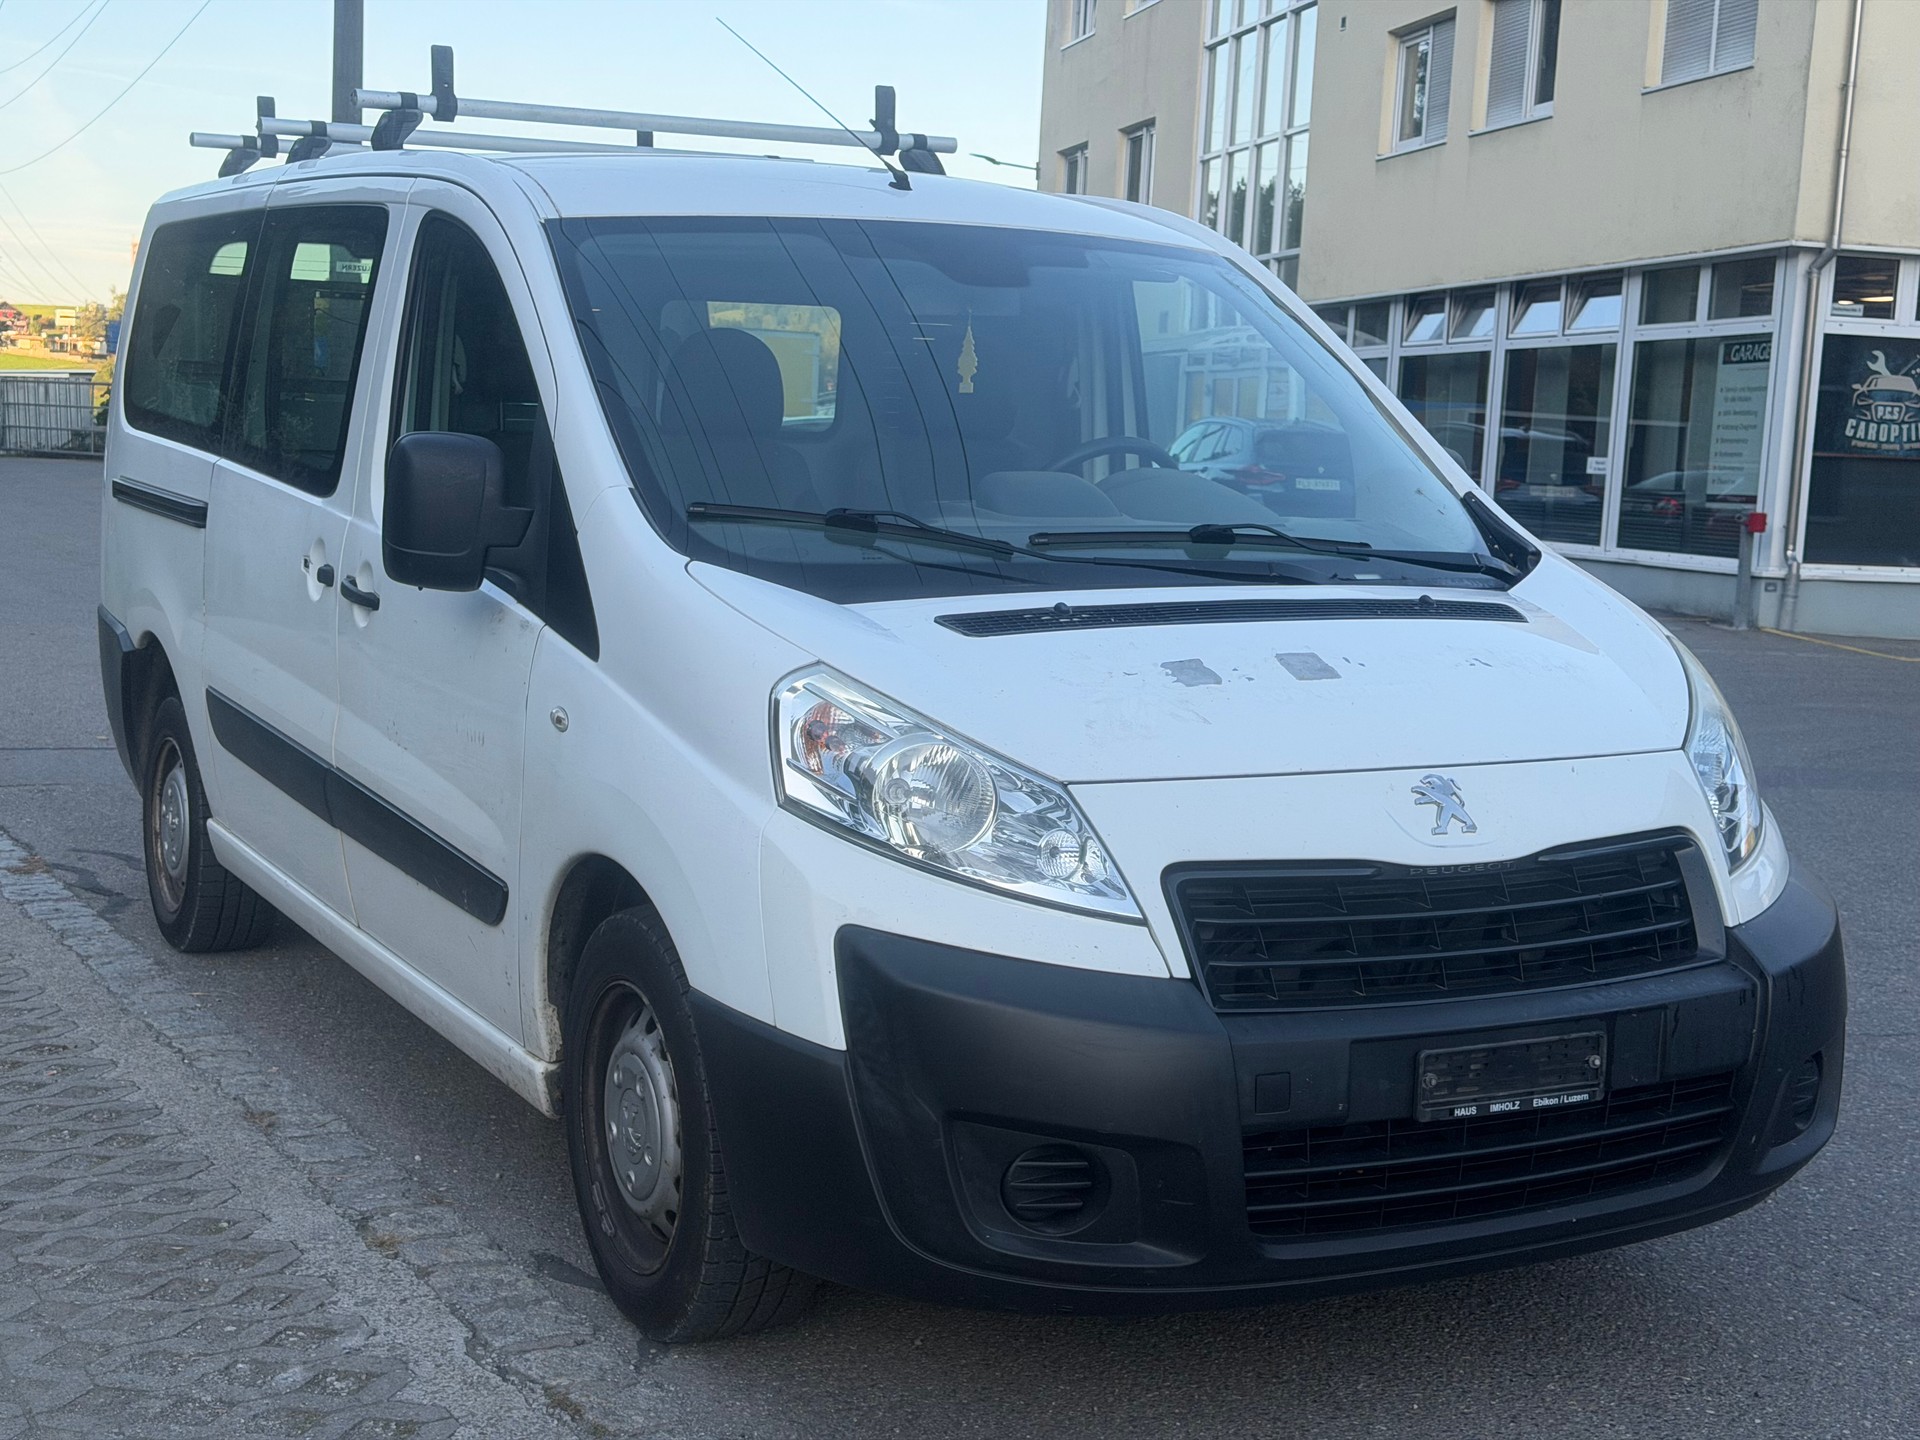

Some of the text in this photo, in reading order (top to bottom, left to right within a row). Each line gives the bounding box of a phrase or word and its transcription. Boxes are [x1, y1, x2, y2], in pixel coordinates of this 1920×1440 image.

[1845, 418, 1920, 442] CAROPTI
[1409, 861, 1514, 875] PEUGEOT
[1454, 1106, 1477, 1117] HAUS
[1489, 1101, 1520, 1113] IMHOLZ
[1532, 1098, 1559, 1107] Ebikon
[1564, 1094, 1589, 1103] Luzern
